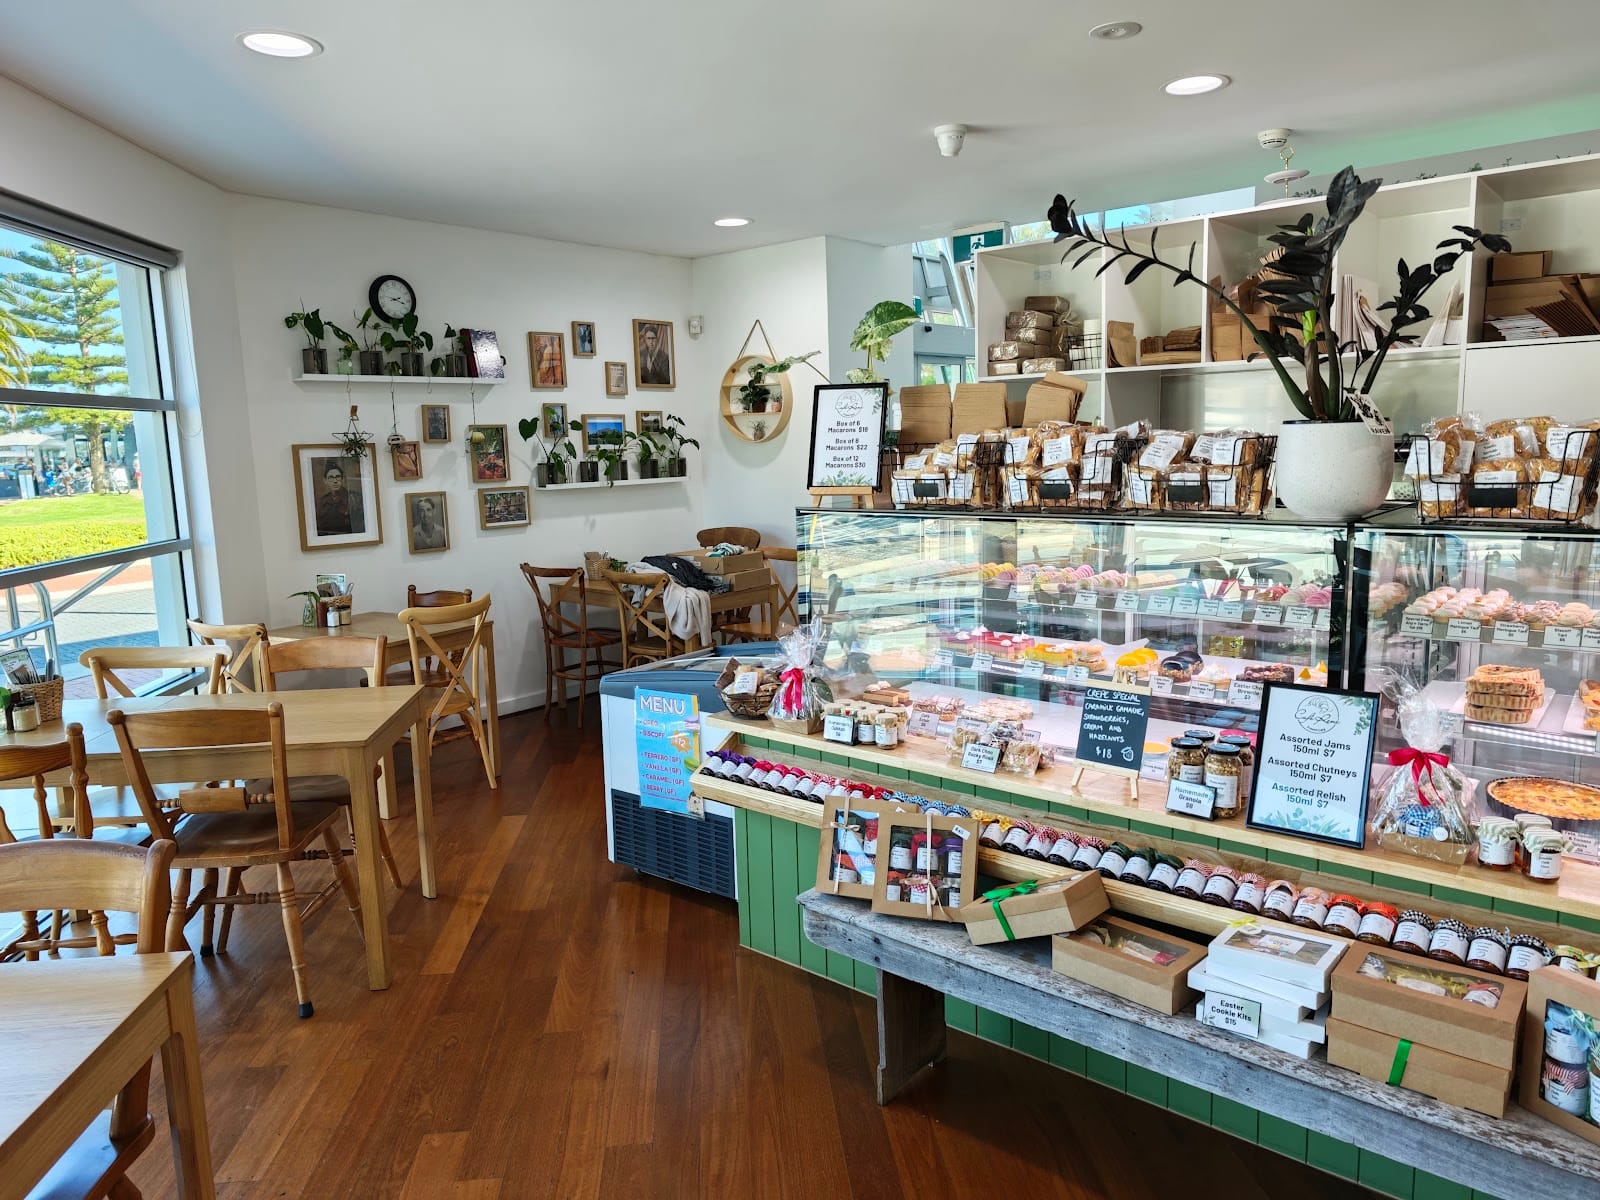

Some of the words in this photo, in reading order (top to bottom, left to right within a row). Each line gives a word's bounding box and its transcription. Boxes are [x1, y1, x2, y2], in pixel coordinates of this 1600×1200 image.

[1233, 682, 1251, 690] Easter
[1112, 691, 1141, 702] SPECIAL
[639, 694, 686, 715] MENU
[642, 719, 659, 727] OREO
[1083, 722, 1103, 731] CREAM
[1108, 724, 1122, 733] AND
[642, 730, 666, 739] BISCOFF
[1088, 732, 1125, 743] HAZELNUTS
[1279, 733, 1322, 746] Assorted
[1324, 740, 1351, 751] Jams
[644, 751, 669, 761] FERRERO
[1095, 746, 1113, 759] $18
[1293, 744, 1320, 756] 150ml
[1323, 748, 1336, 758] $7
[644, 762, 668, 772] VANILLA
[1267, 756, 1310, 770] Assorted
[1312, 763, 1358, 779] Chutneys
[645, 773, 672, 783] CARAMEL
[672, 777, 685, 787] (GF)
[1290, 769, 1316, 781] 150ml
[1319, 774, 1332, 783] $7
[646, 784, 664, 793] BERRY
[1174, 786, 1209, 798] Homemade
[1272, 782, 1315, 797] Assorted
[1316, 789, 1346, 802] Relish
[1178, 793, 1202, 804] Granola
[1286, 794, 1313, 806] 150ml
[1316, 799, 1329, 809] $7
[1220, 999, 1244, 1011] Easter
[1211, 1005, 1236, 1017] Cookie
[1237, 1012, 1252, 1022] Kits
[1224, 1017, 1237, 1026] $15
